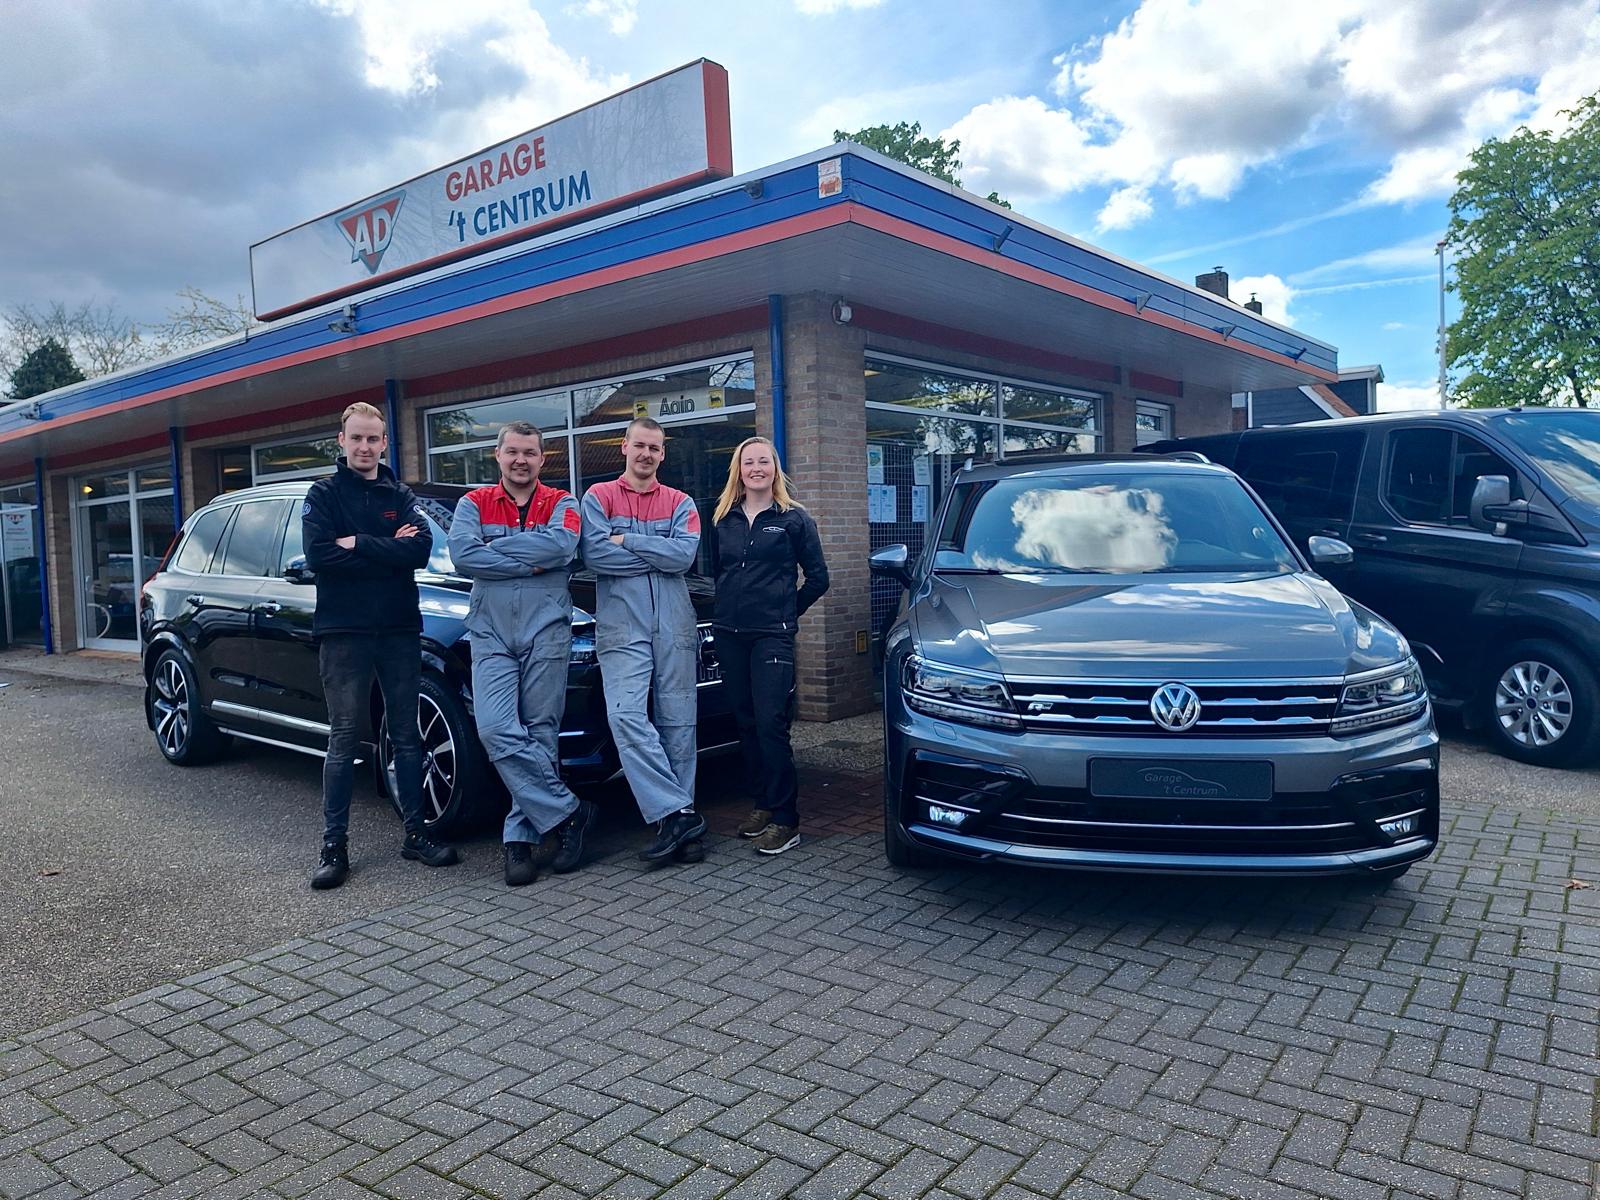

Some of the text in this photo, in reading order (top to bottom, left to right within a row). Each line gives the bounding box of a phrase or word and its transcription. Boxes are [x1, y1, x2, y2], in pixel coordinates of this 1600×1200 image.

[445, 136, 546, 201] GARAGE
[473, 170, 592, 236] CENTRUM
[351, 208, 393, 263] AD
[1144, 772, 1183, 783] Garage
[1173, 785, 1218, 796] Centrum
